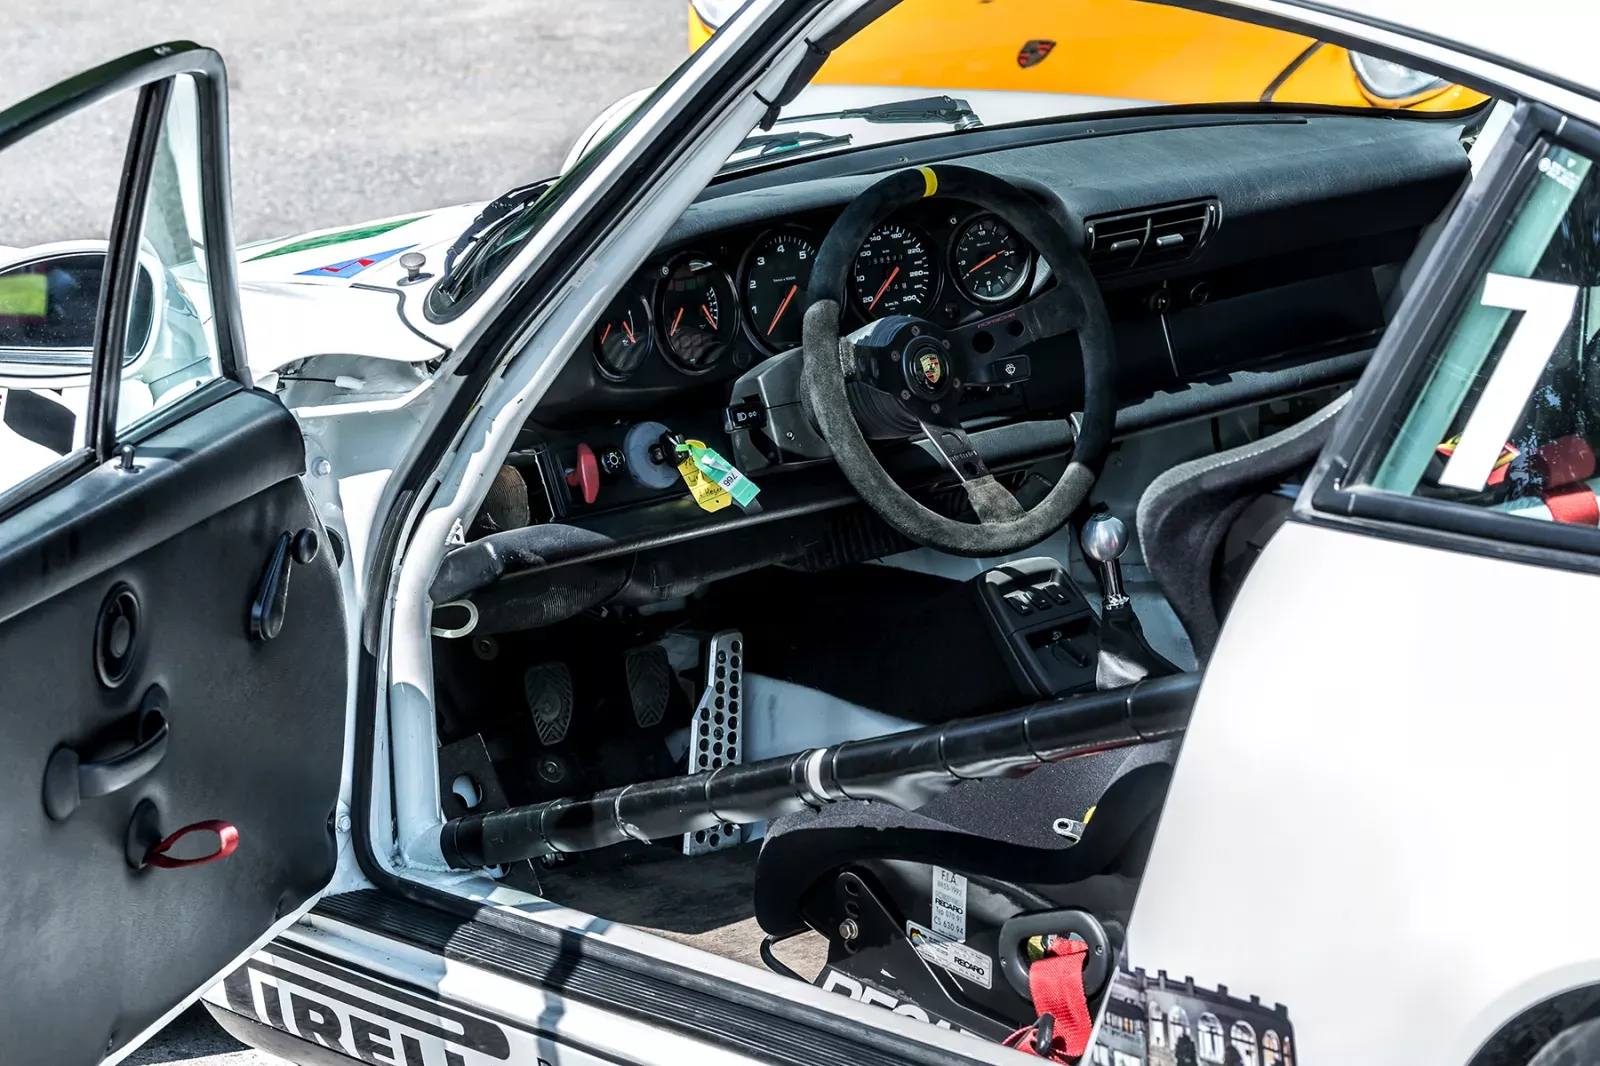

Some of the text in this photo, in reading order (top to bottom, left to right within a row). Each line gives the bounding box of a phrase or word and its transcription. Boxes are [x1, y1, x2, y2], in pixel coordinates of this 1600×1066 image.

[1438, 272, 1579, 492] 7
[722, 472, 739, 488] 766
[935, 897, 963, 915] RECARO
[953, 956, 985, 976] RECARO
